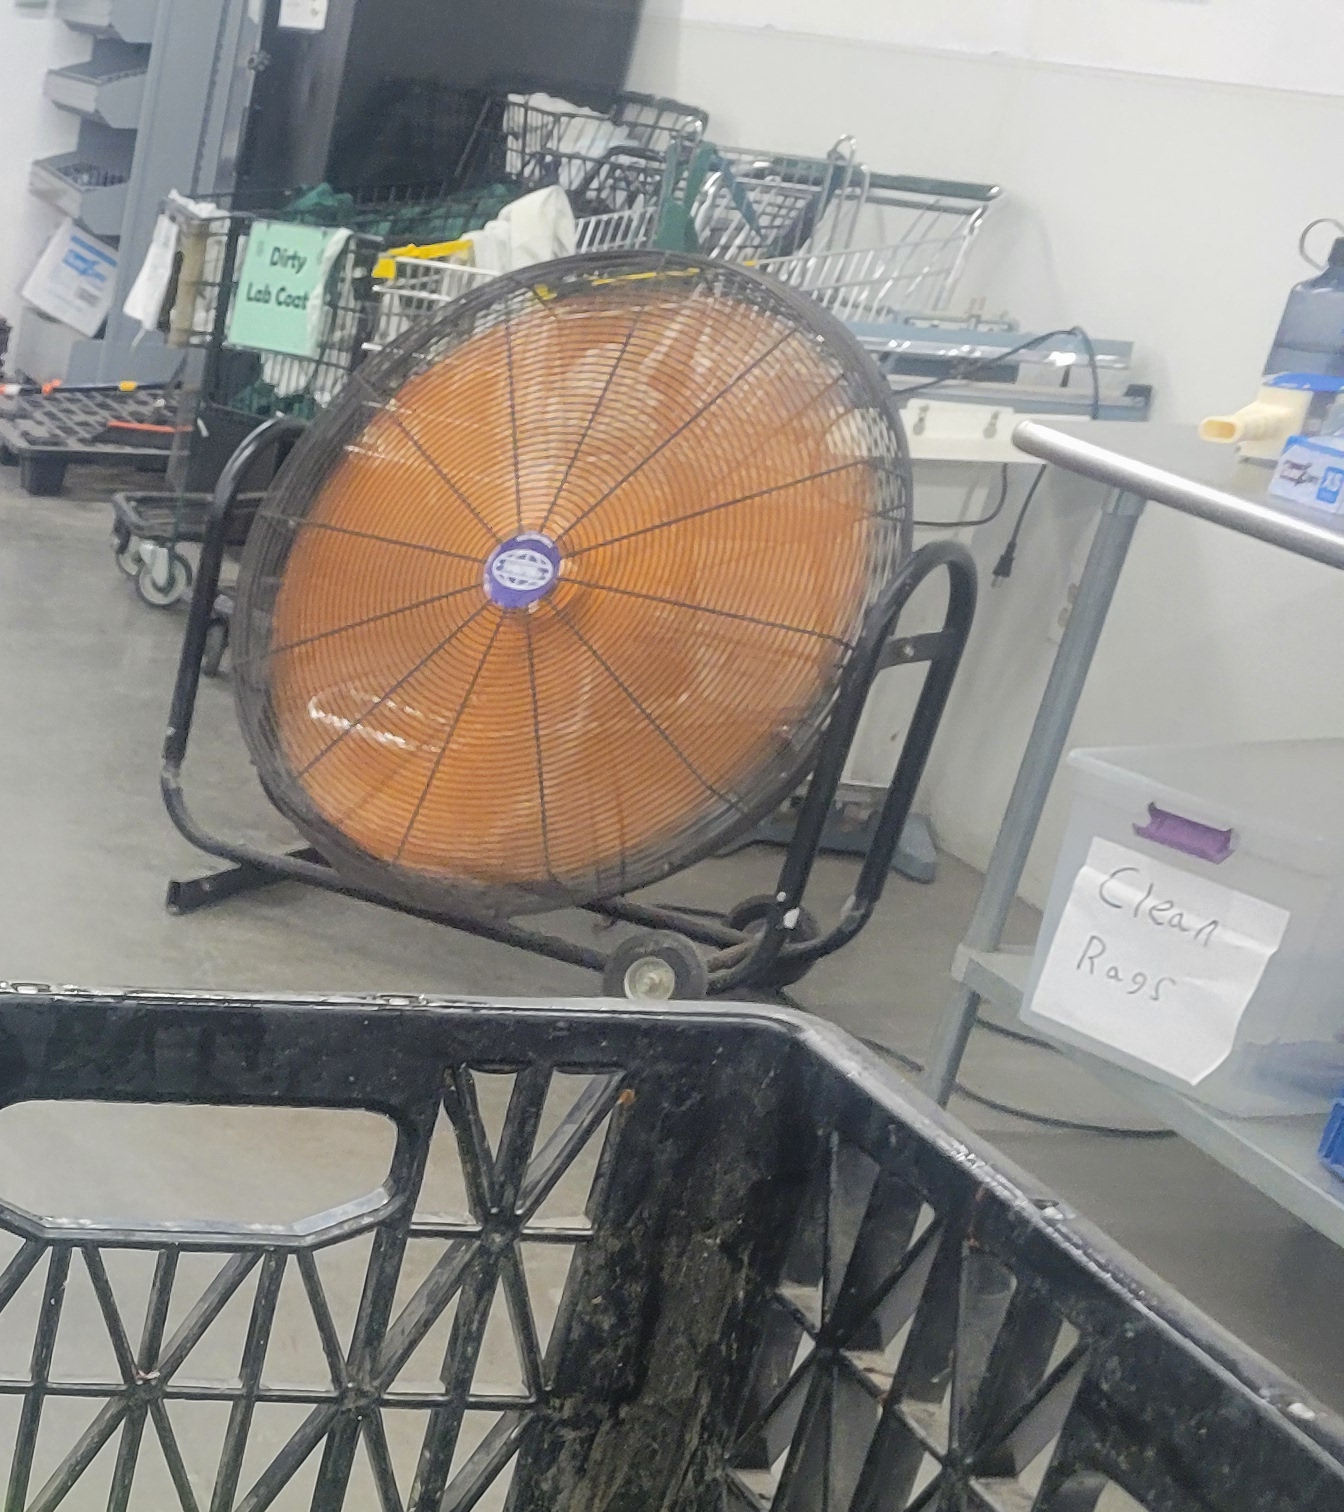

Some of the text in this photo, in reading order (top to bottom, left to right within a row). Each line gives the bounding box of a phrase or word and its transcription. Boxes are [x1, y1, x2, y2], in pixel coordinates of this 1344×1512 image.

[270, 246, 307, 274] Dirty
[246, 281, 310, 310] Lab Coat
[1098, 866, 1220, 948] Clean
[1076, 935, 1177, 1001] Rags
